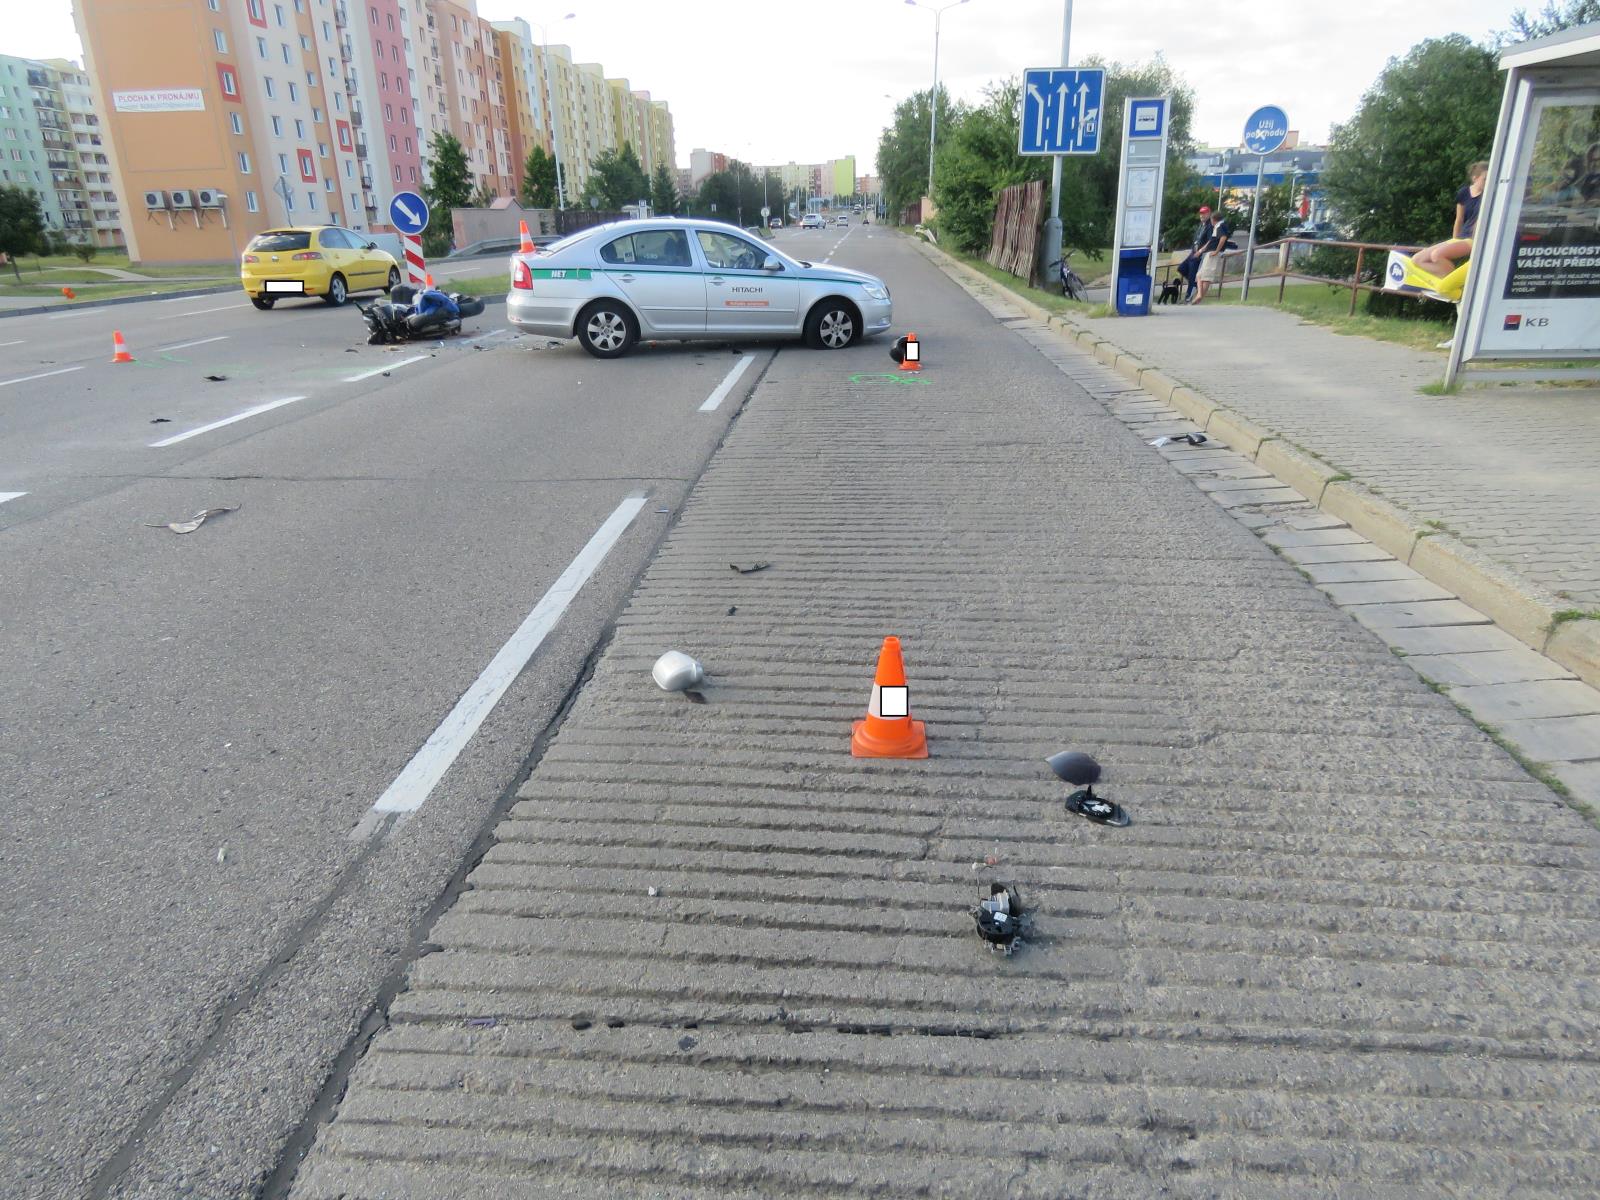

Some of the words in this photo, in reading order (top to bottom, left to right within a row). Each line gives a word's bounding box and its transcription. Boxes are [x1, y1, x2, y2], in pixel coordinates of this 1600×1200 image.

[1518, 246, 1600, 256] BUDOUCNOST
[1517, 257, 1560, 268] VAŠICH
[1525, 318, 1549, 327] KB
